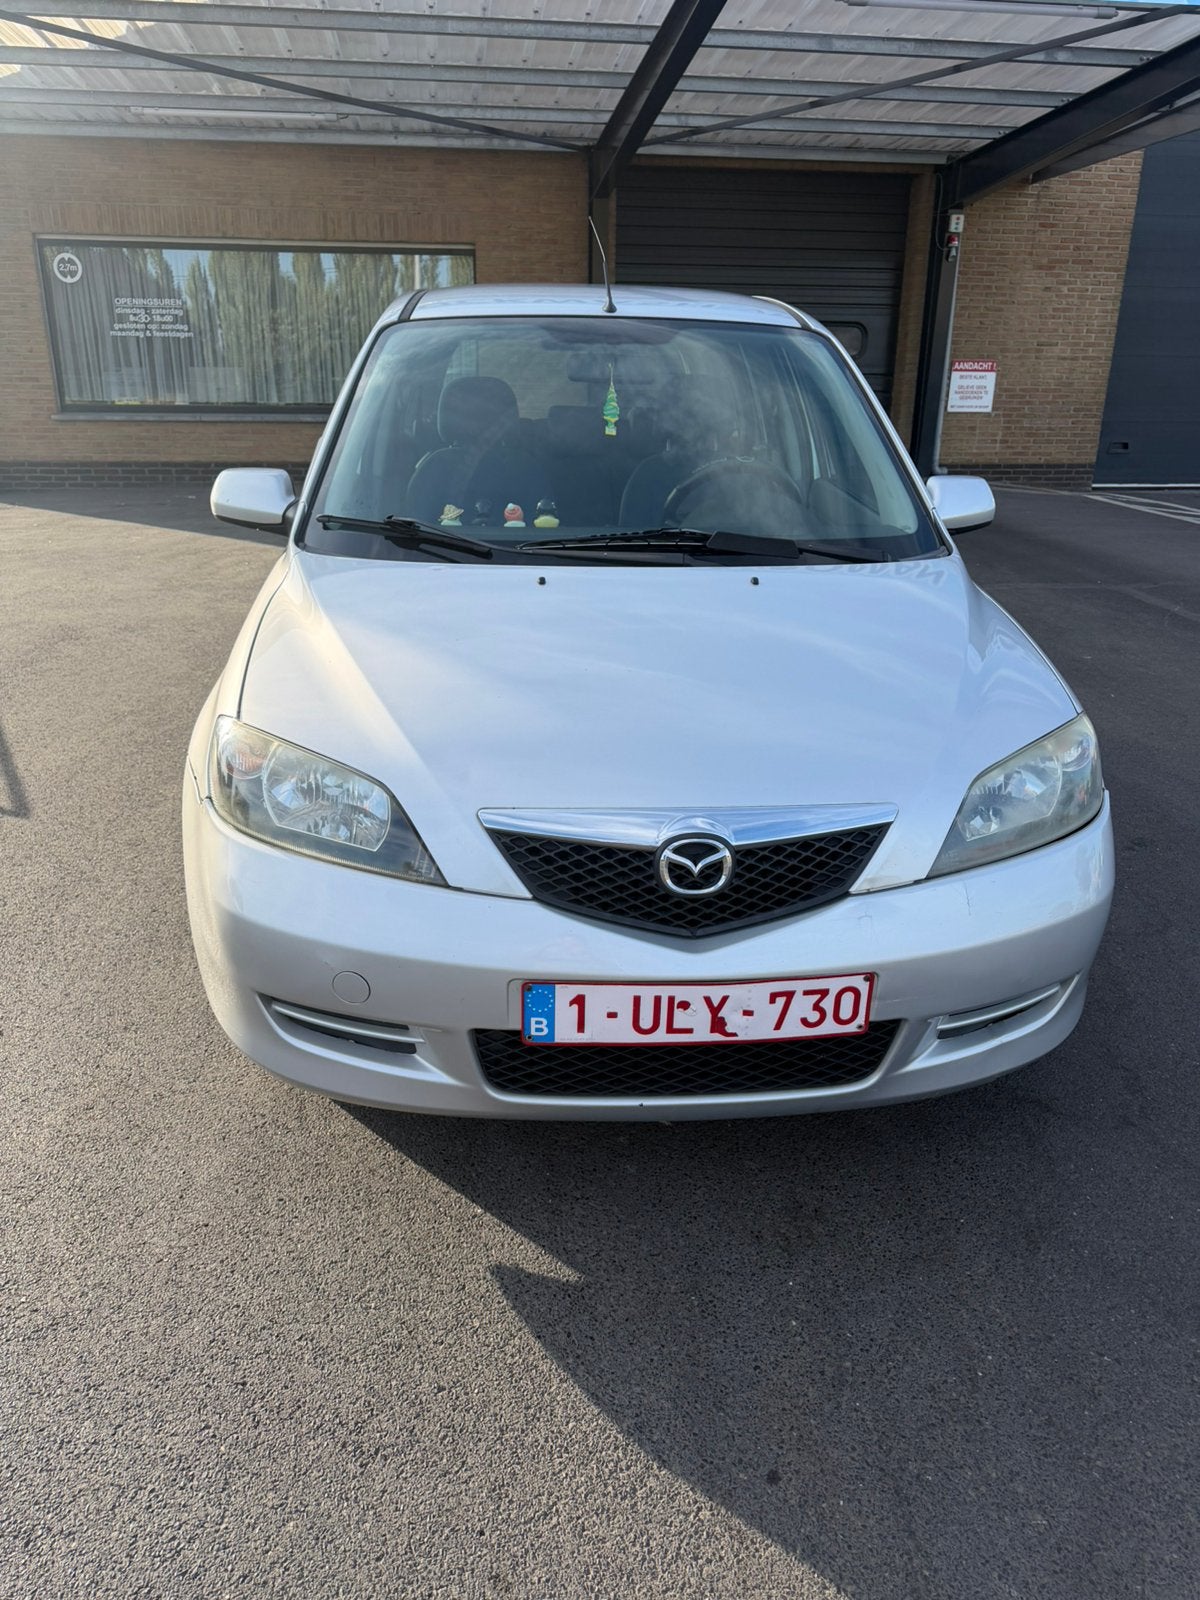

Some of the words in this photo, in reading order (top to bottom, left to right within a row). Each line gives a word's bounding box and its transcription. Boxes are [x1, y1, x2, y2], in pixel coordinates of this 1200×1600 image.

[114, 297, 183, 306] OPENINGSUREN
[115, 307, 146, 315] dinsdag
[151, 308, 184, 317] zaterdag
[113, 322, 146, 331] gesloten
[161, 323, 189, 332] zondag
[110, 330, 145, 339] maandag
[152, 331, 194, 340] feestdagen
[954, 362, 992, 370] AANDACHT
[530, 1017, 549, 1036] B
